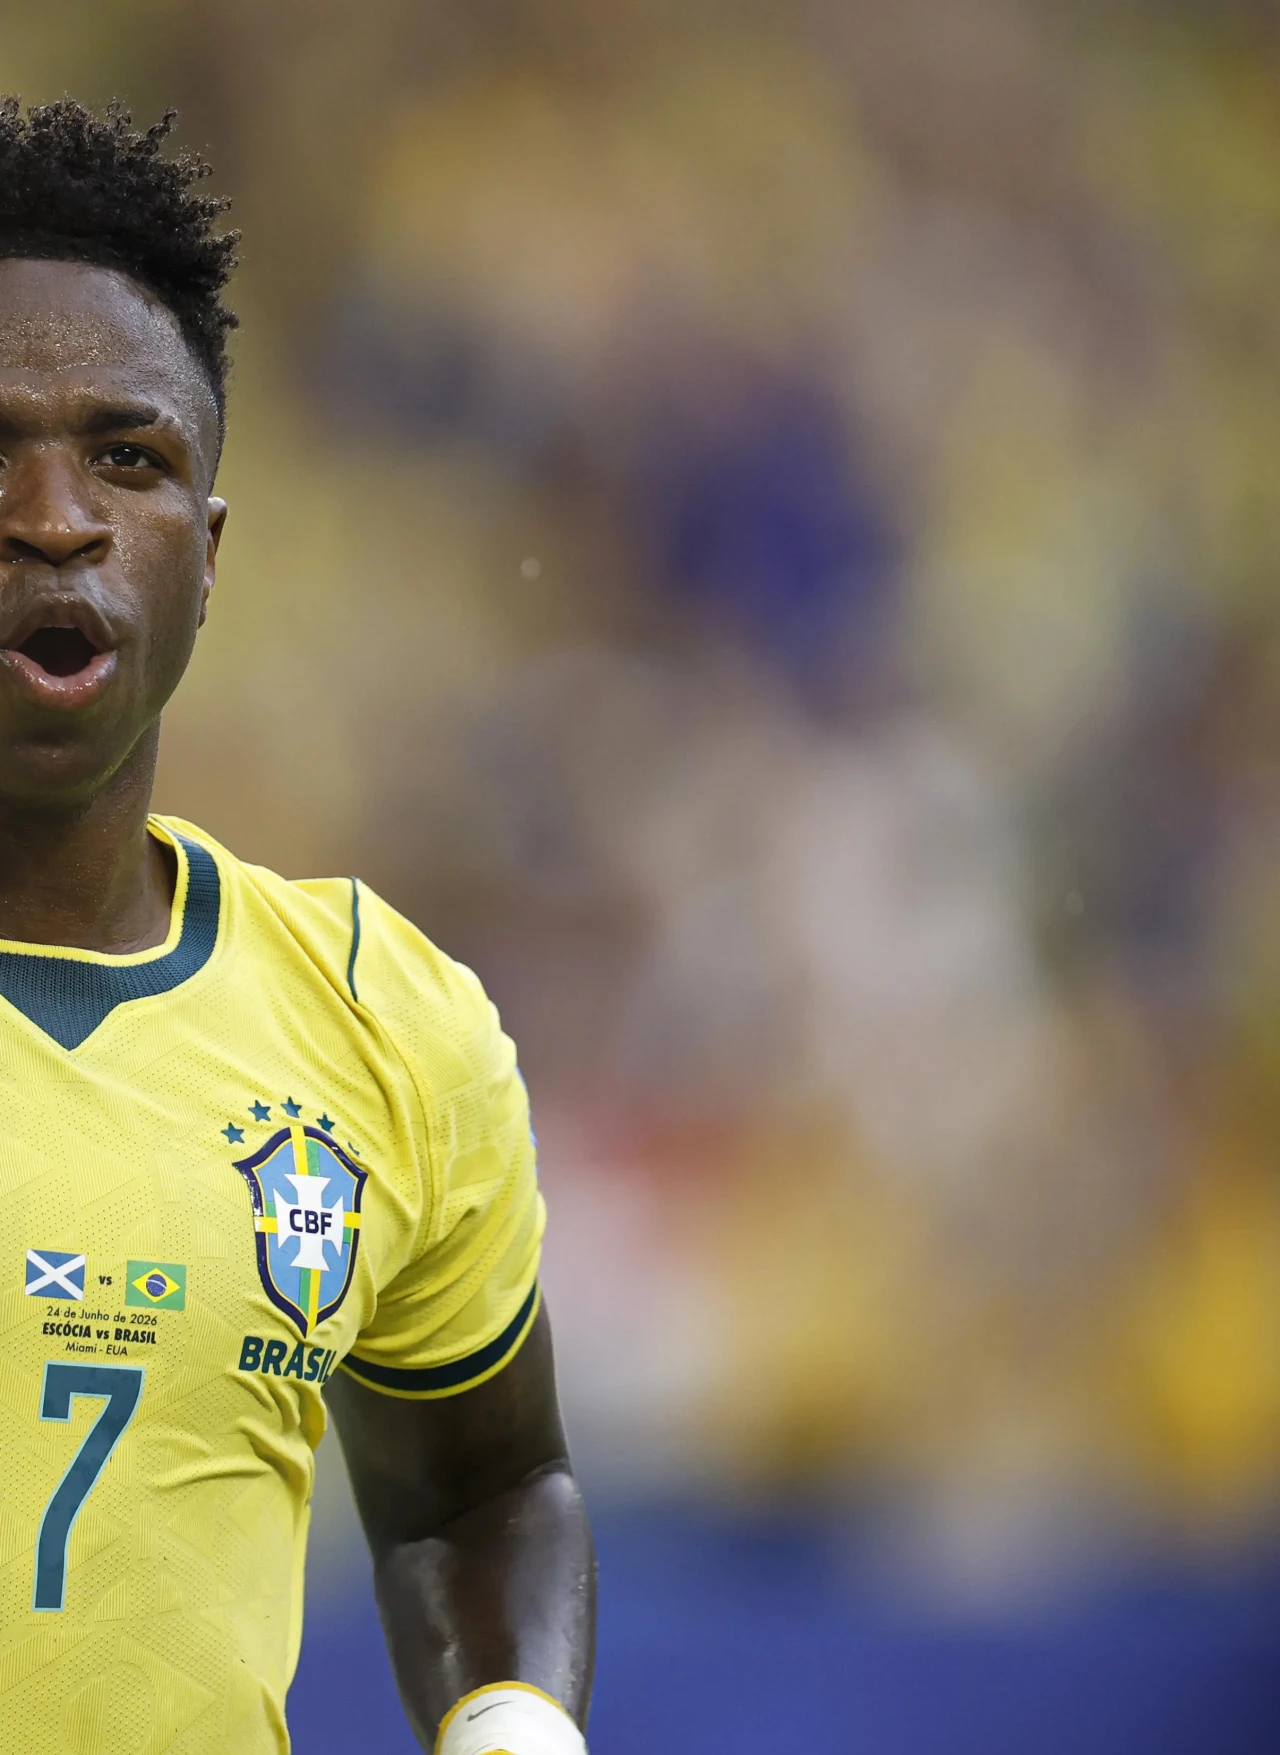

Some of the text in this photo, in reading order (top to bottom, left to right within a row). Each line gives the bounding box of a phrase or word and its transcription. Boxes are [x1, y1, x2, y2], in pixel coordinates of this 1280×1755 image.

[289, 1208, 333, 1236] CBF
[99, 1275, 112, 1286] vs
[47, 1306, 157, 1326] 24 de Junho de 2026
[42, 1321, 157, 1344] ESCÓCIA vs BRASIL
[65, 1342, 97, 1354] Miami
[106, 1344, 128, 1356] EUA
[31, 1360, 146, 1612] 7
